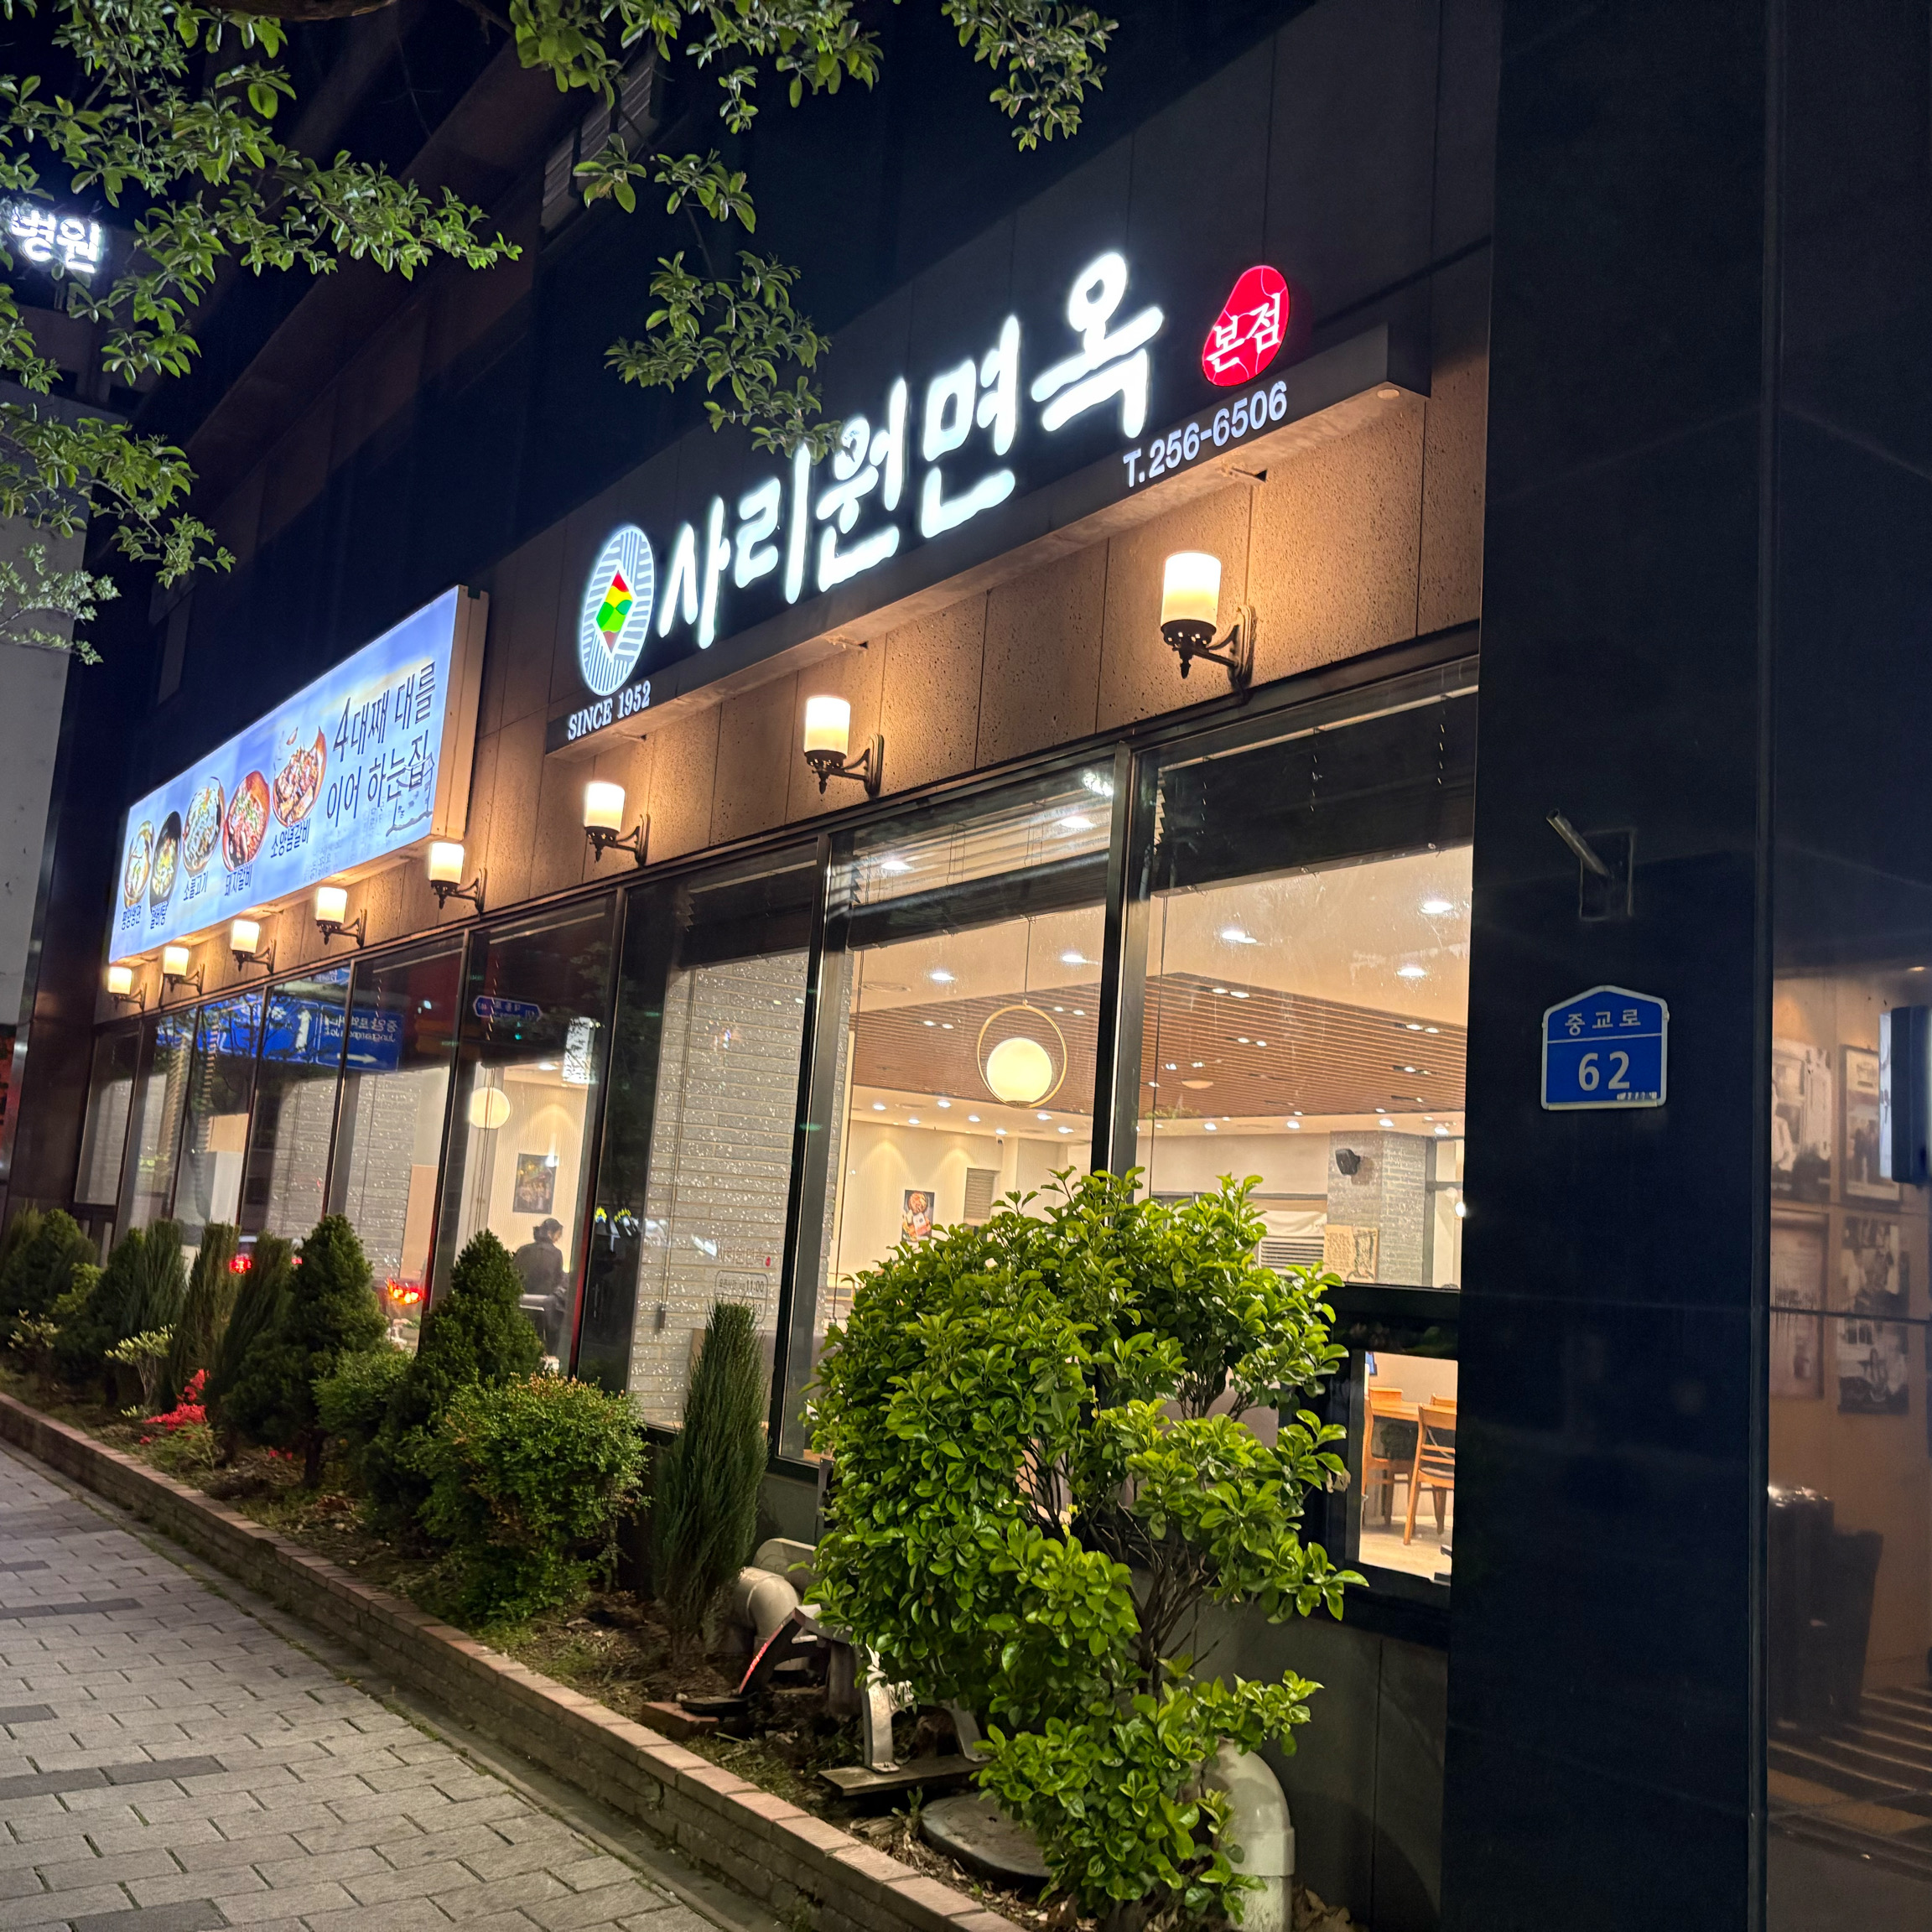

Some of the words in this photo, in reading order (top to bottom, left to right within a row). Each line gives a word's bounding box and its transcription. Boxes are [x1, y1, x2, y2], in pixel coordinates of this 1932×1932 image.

[1206, 293, 1281, 373] 본점
[657, 250, 1166, 651] 사리원면옥
[1123, 380, 1288, 488] T.256-6506
[333, 689, 390, 763] 4대째
[395, 662, 436, 730] 대를
[568, 698, 613, 741] SINCE
[617, 680, 652, 719] 1952
[326, 766, 362, 828] 이어
[270, 818, 311, 859] 소양념갈비
[183, 870, 209, 901] 소불고기
[1565, 1009, 1641, 1036] 중교로
[1578, 1051, 1630, 1092] 62
[746, 1280, 765, 1293] 11:00
